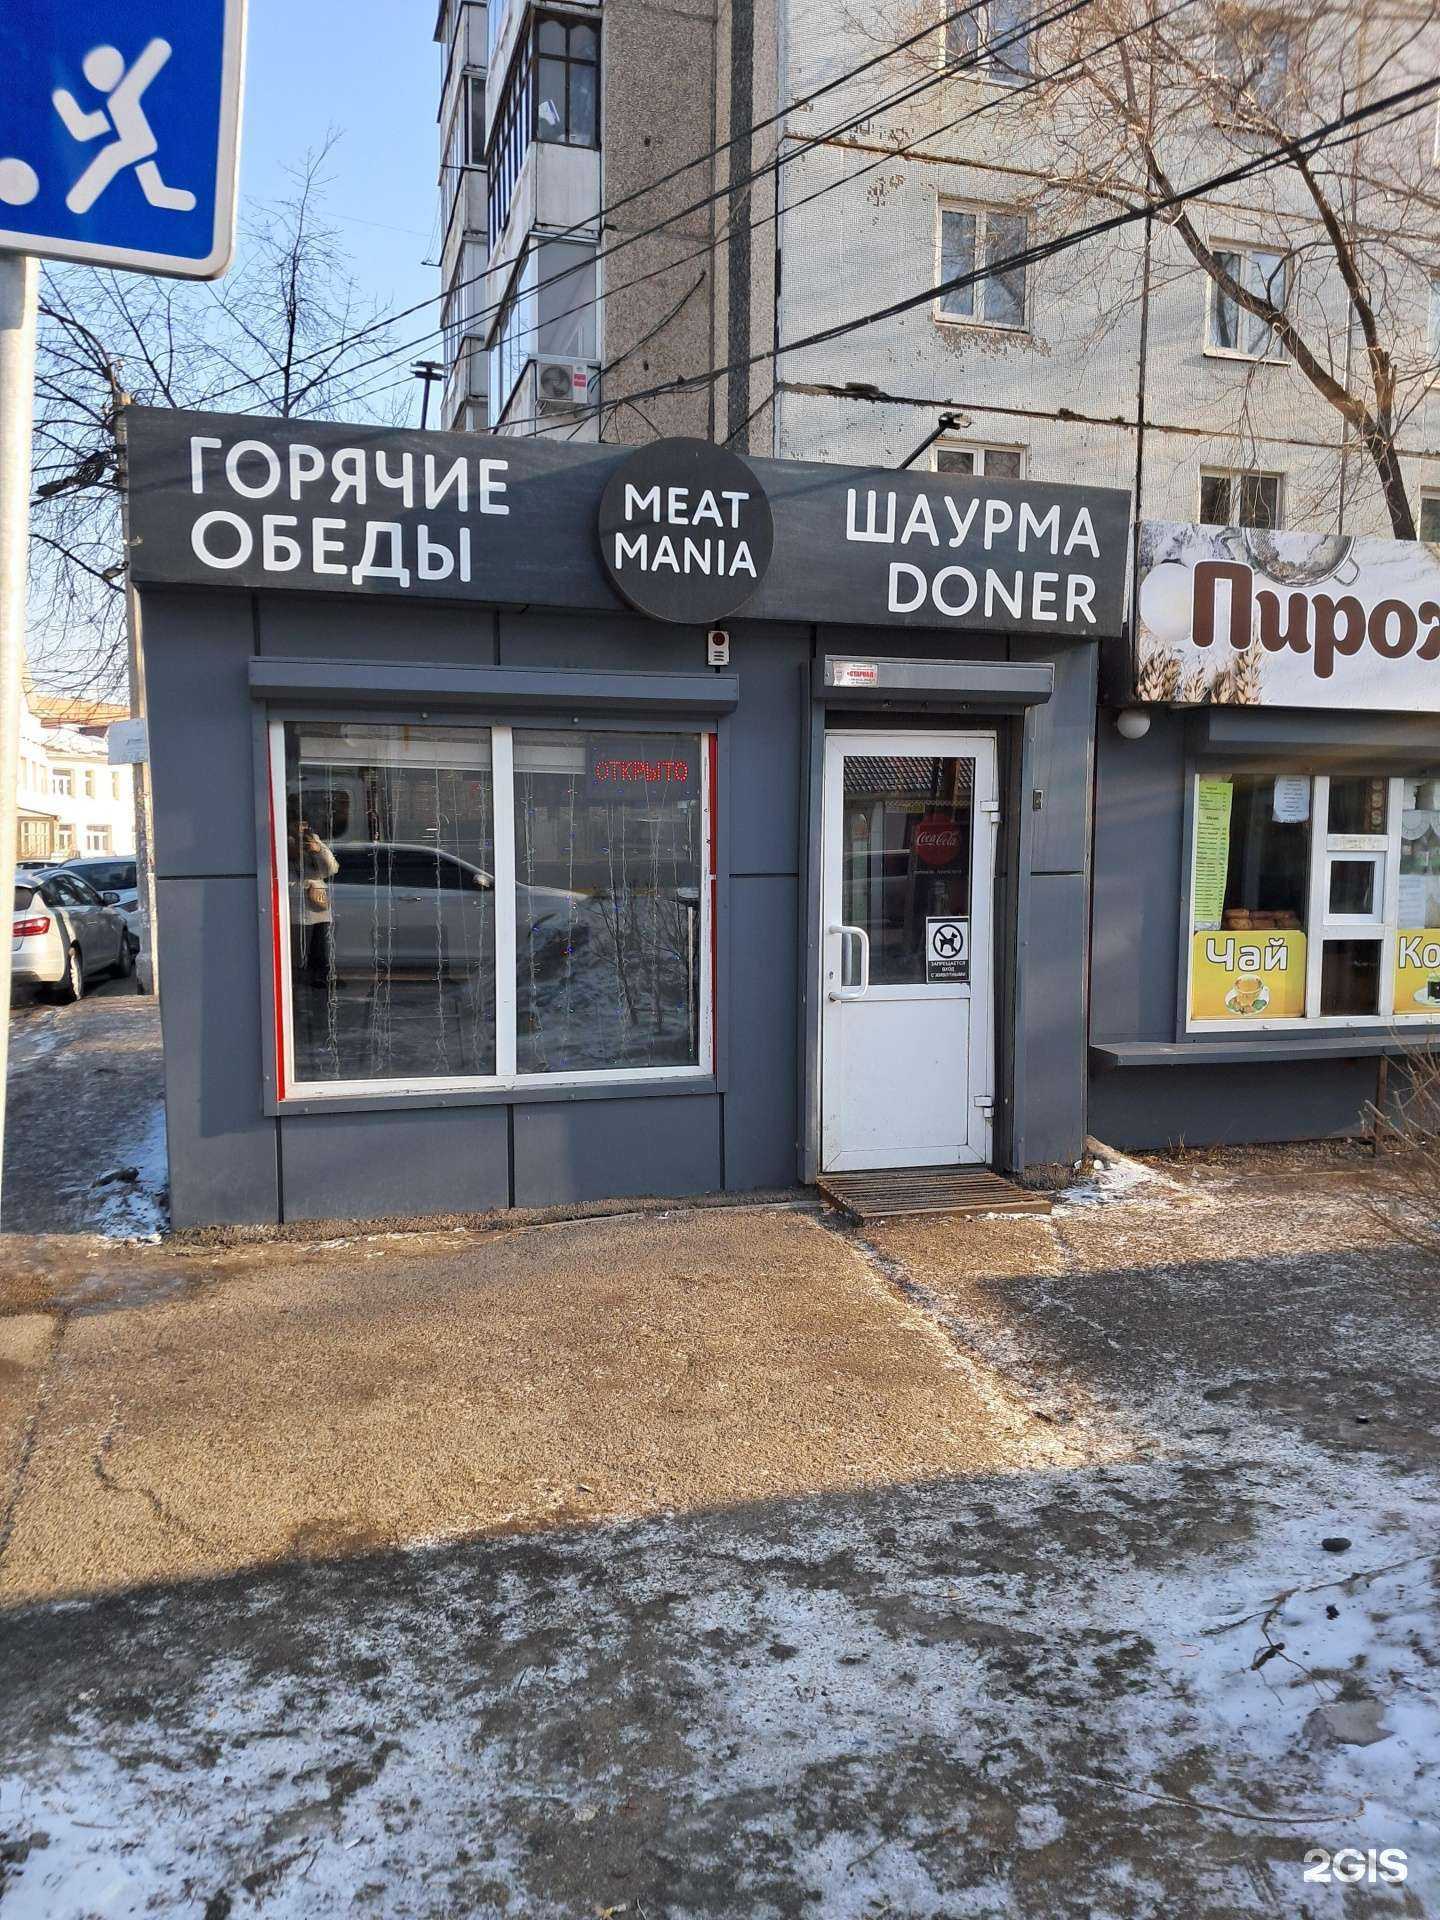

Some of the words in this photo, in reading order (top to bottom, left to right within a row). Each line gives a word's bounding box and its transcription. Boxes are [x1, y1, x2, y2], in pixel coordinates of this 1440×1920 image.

[189, 436, 511, 516] ГОРЯЧИЕ
[624, 483, 750, 529] MEAT
[845, 488, 1101, 559] ШАУРМА
[190, 510, 472, 588] ОБЕДЫ
[614, 533, 759, 578] MANIA
[887, 562, 1098, 625] DONER
[595, 760, 688, 783] ОТКРЫТО
[1206, 937, 1289, 972] Чай
[1398, 935, 1440, 969] Ко
